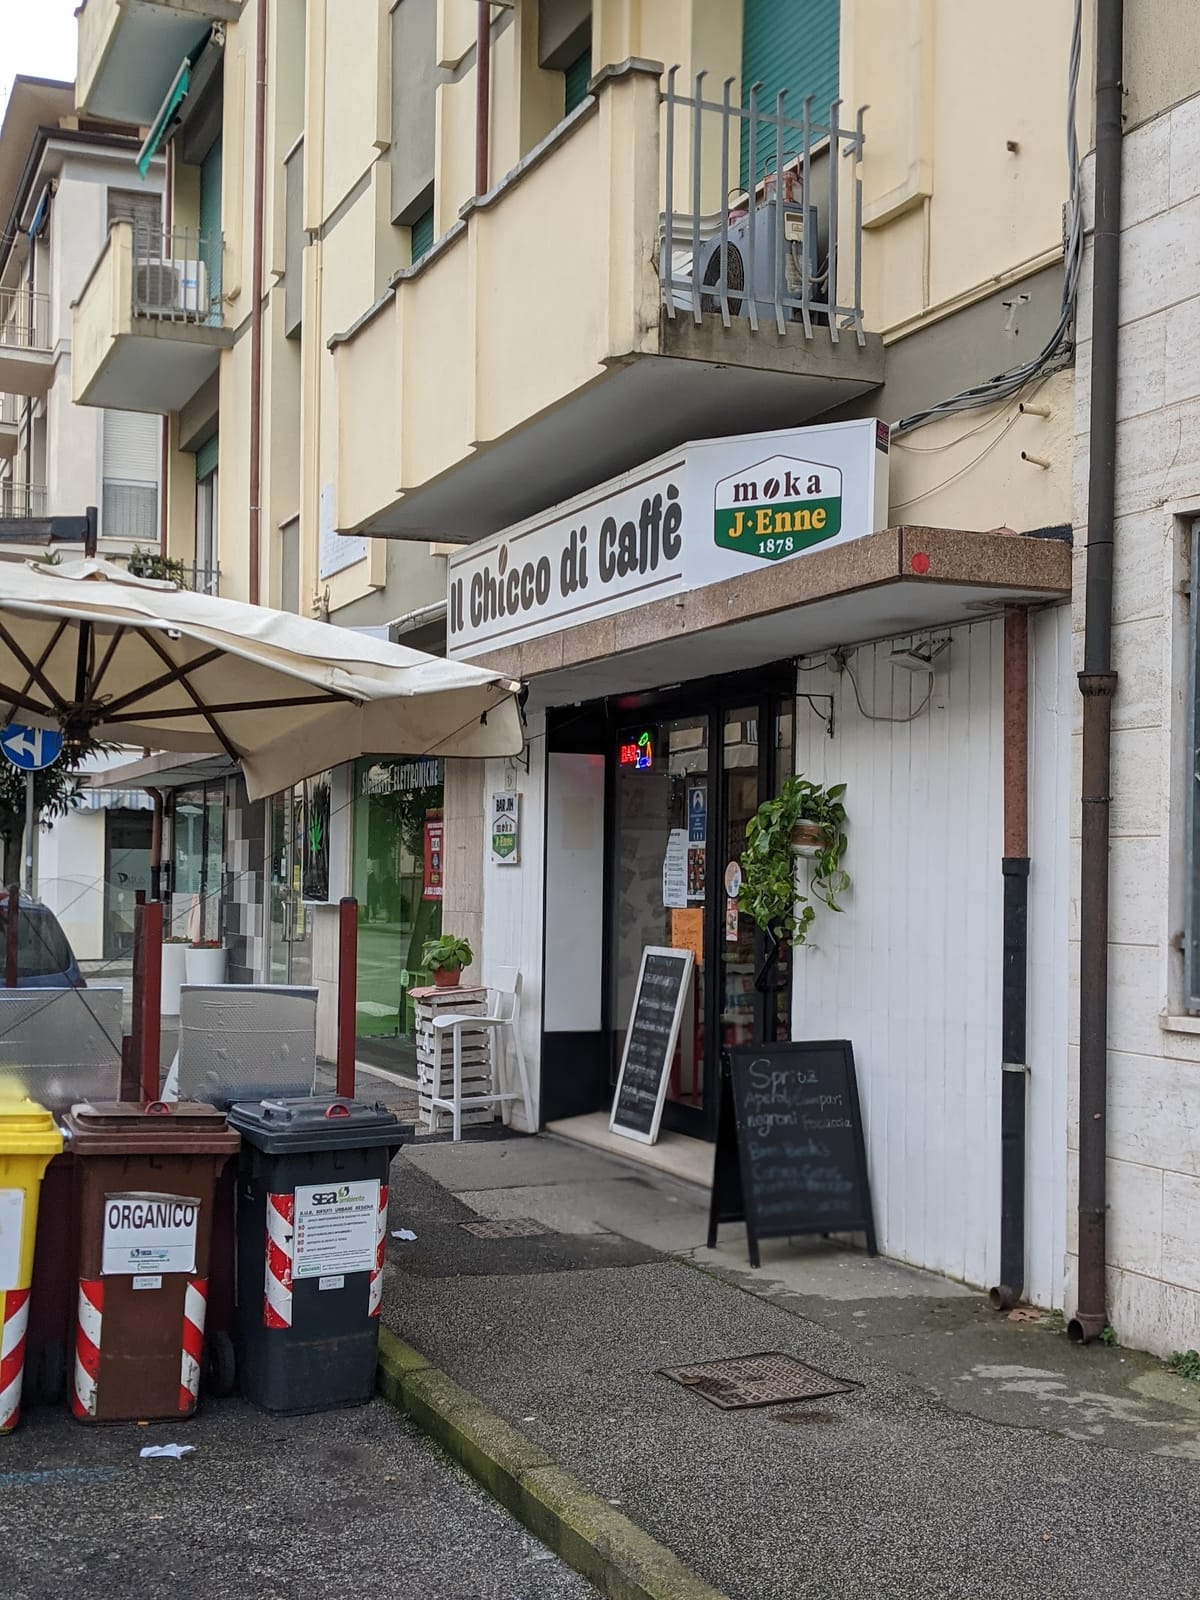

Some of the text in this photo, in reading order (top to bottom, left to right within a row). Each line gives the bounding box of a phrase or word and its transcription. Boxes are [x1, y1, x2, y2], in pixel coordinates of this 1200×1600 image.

[733, 471, 822, 502] moka
[759, 536, 794, 554] 1878
[450, 483, 682, 634] Il Chicco di Caffè
[621, 744, 637, 763] BAR
[496, 799, 506, 812] BAR
[109, 1203, 195, 1229] ORGANICO
